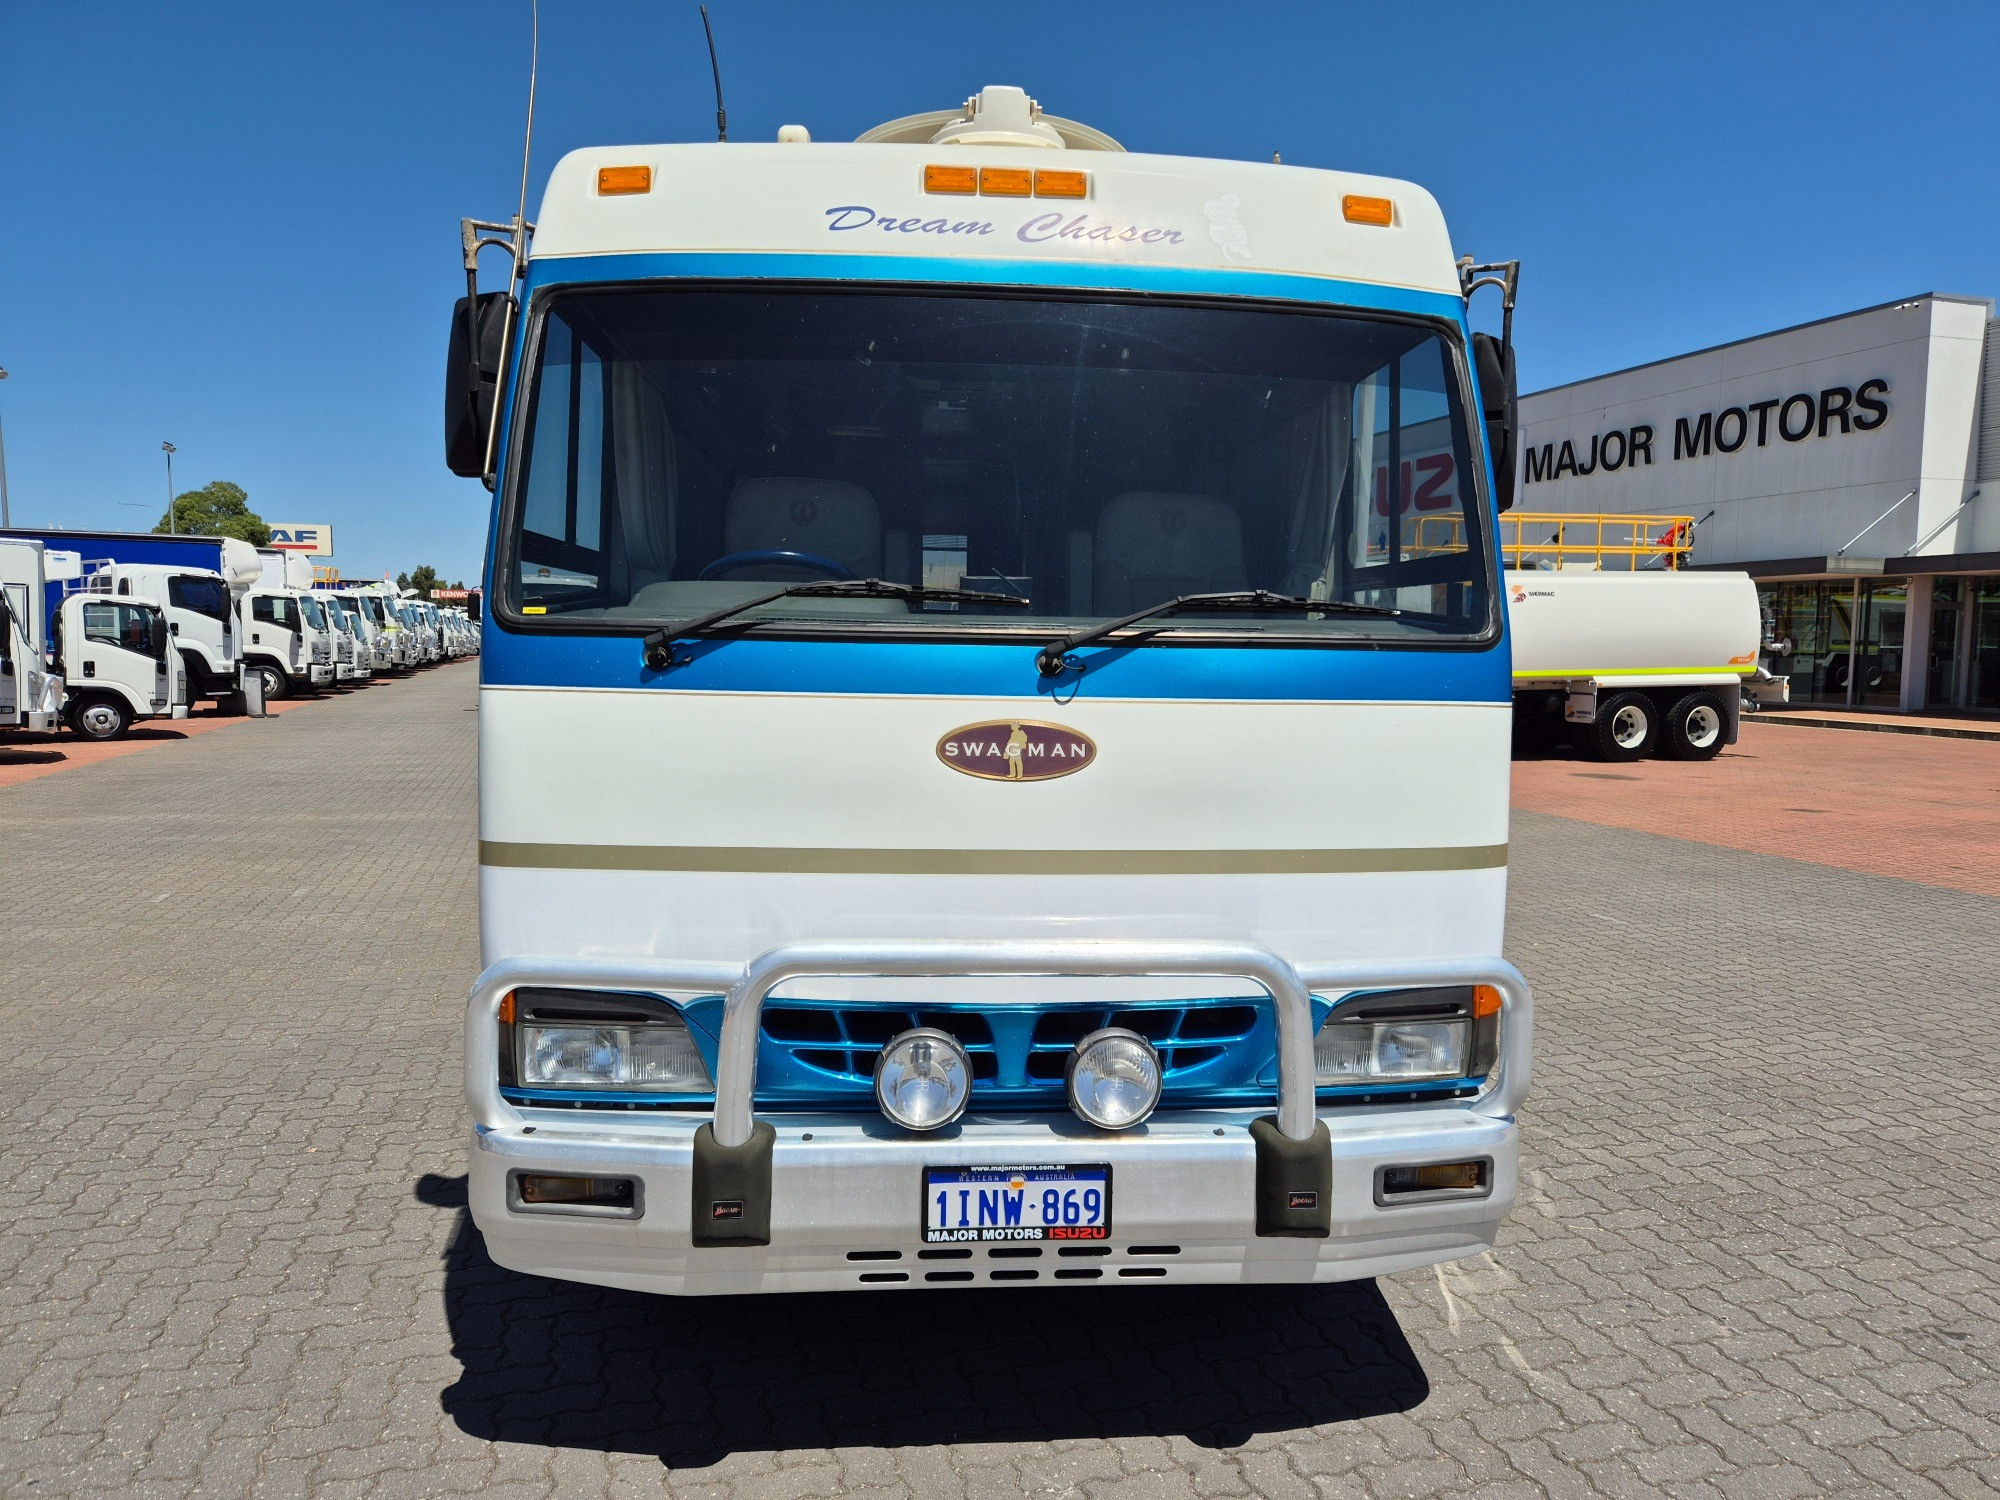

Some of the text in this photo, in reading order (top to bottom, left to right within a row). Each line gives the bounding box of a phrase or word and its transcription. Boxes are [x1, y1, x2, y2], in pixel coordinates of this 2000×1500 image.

[825, 206, 1185, 245] Dream Chaser
[1524, 378, 1891, 485] MAJOR MOTORS
[269, 530, 317, 542] AF
[944, 742, 1087, 758] SWAGMAN
[970, 1164, 1066, 1172] www.majormotors.com.au
[958, 1173, 1076, 1182] WESTERN AUSTRALIA
[927, 1227, 1106, 1242] MAJOR MOTORS ISUZU
